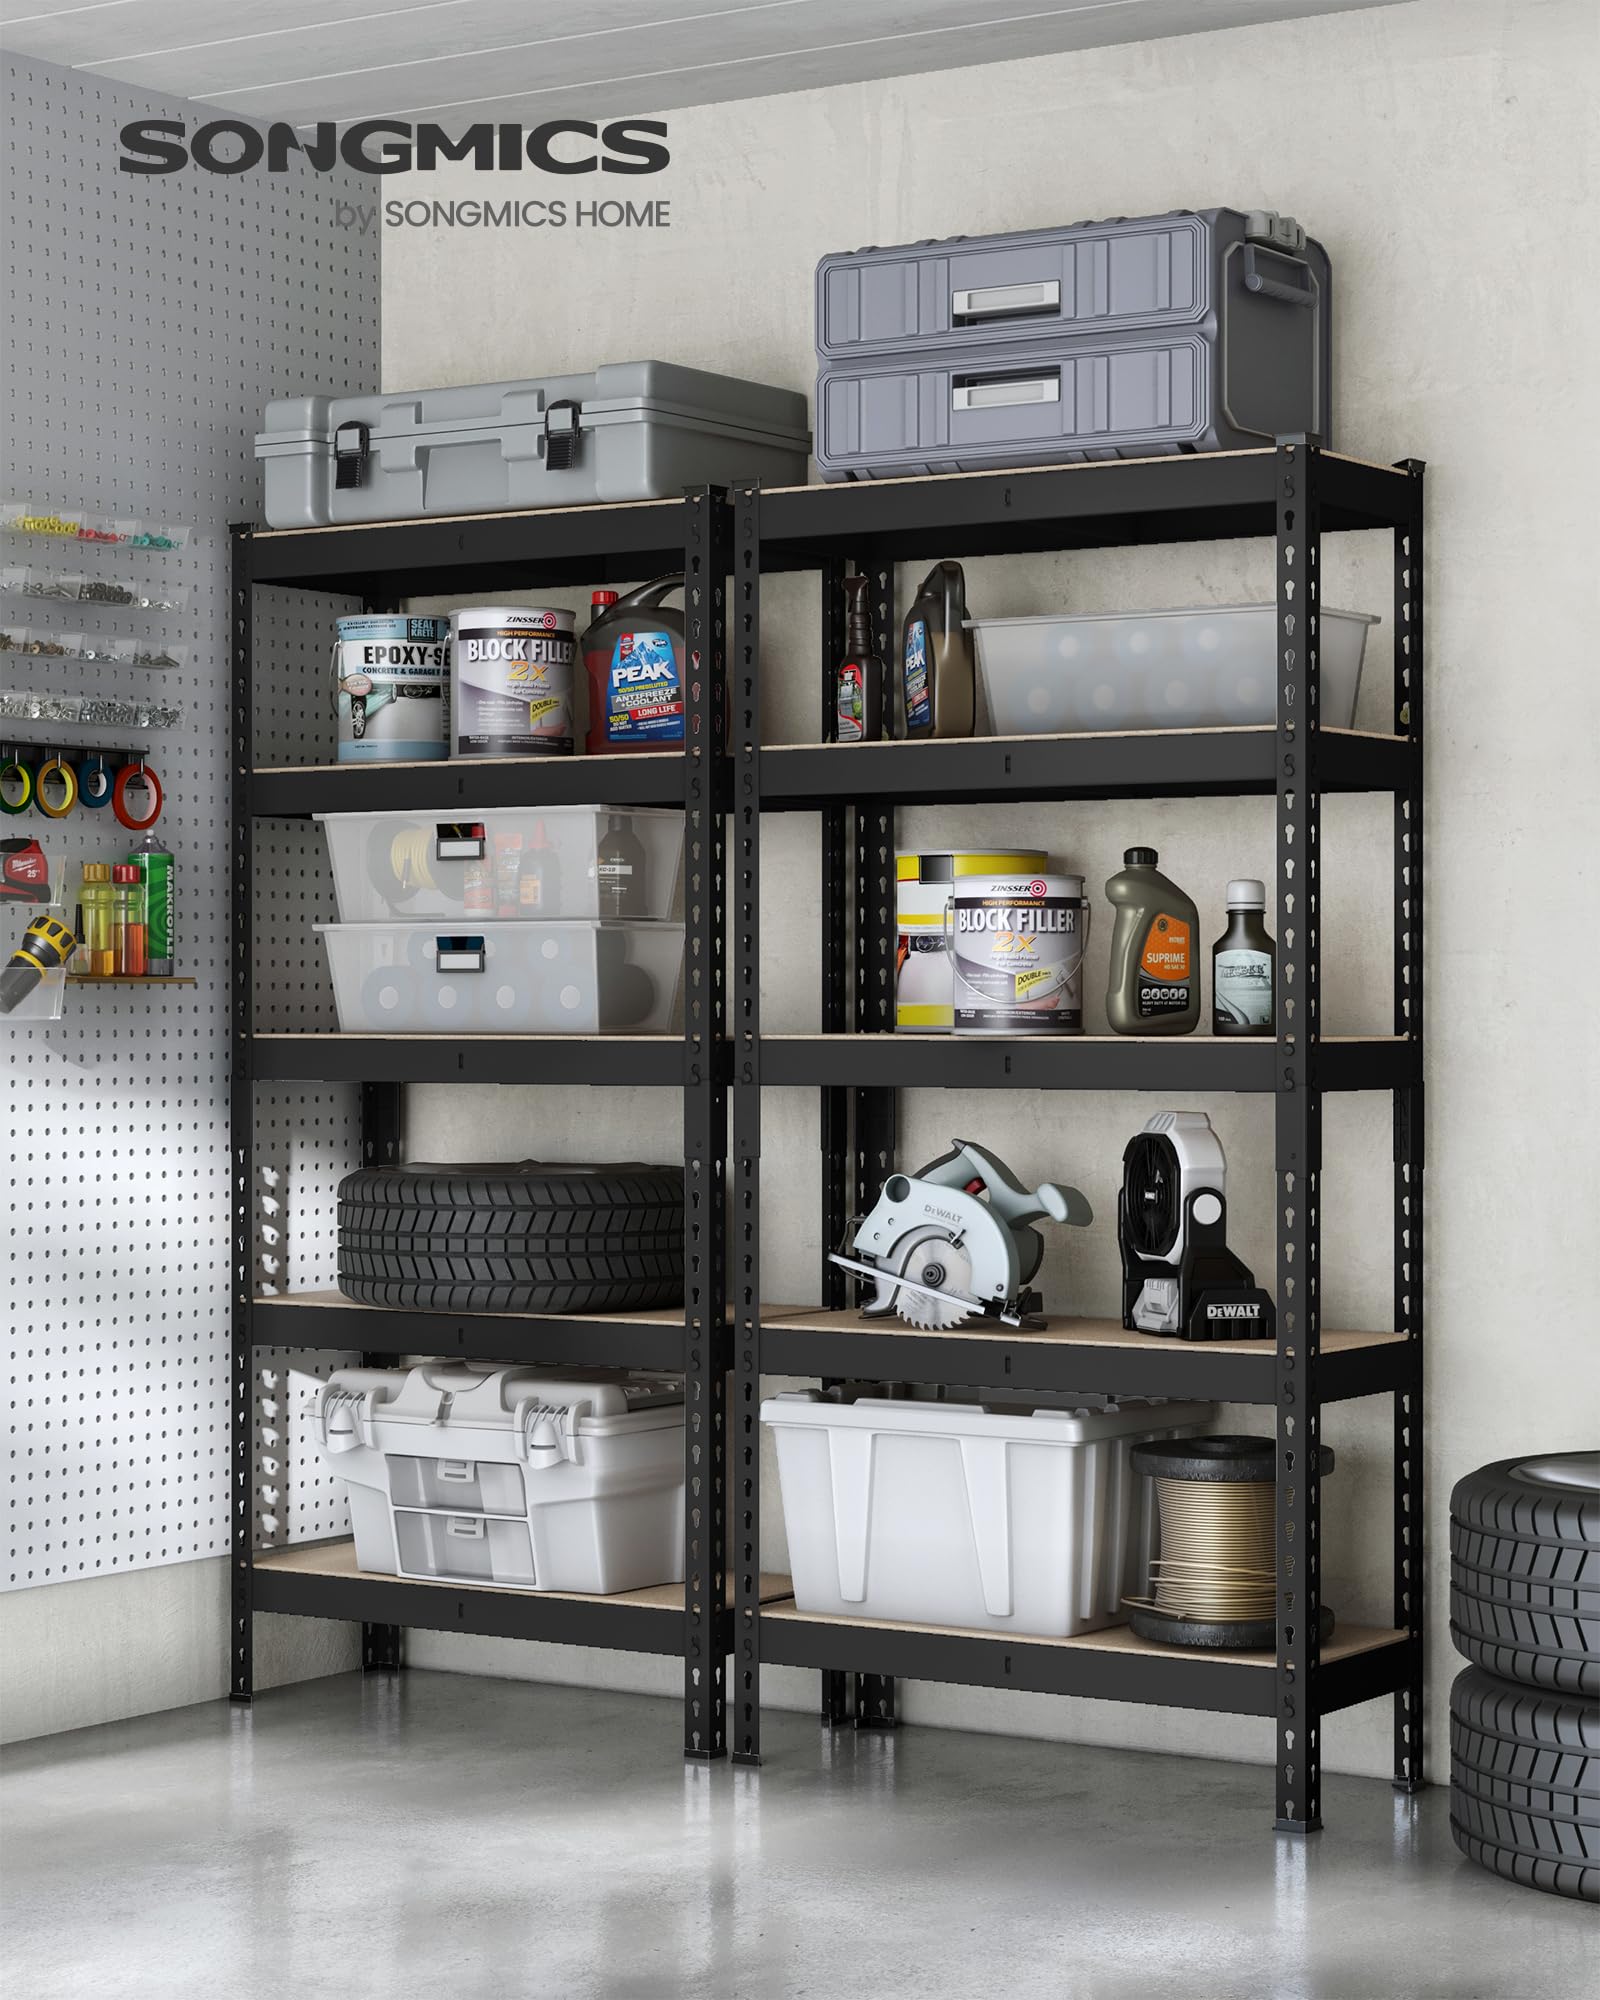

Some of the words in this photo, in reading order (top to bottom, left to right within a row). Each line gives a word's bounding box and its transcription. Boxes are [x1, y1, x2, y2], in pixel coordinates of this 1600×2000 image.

[411, 618, 433, 629] SEAL
[506, 616, 544, 624] ZINSSER
[411, 629, 434, 637] KRETE
[514, 630, 556, 638] PERFORMANCE
[468, 639, 528, 662] BLOCK
[906, 649, 926, 675] PEAK
[362, 667, 398, 675] CONCRETE
[400, 667, 407, 675] &
[612, 661, 675, 688] PEAK
[615, 688, 677, 703] ANTIFREEZE
[637, 707, 658, 717] LONG
[609, 714, 629, 723] 50/50
[959, 909, 1012, 932] BLOCK
[1016, 909, 1075, 933] FILLER
[1146, 953, 1185, 963] SUPRIME
[1017, 971, 1041, 986] DOUBLE
